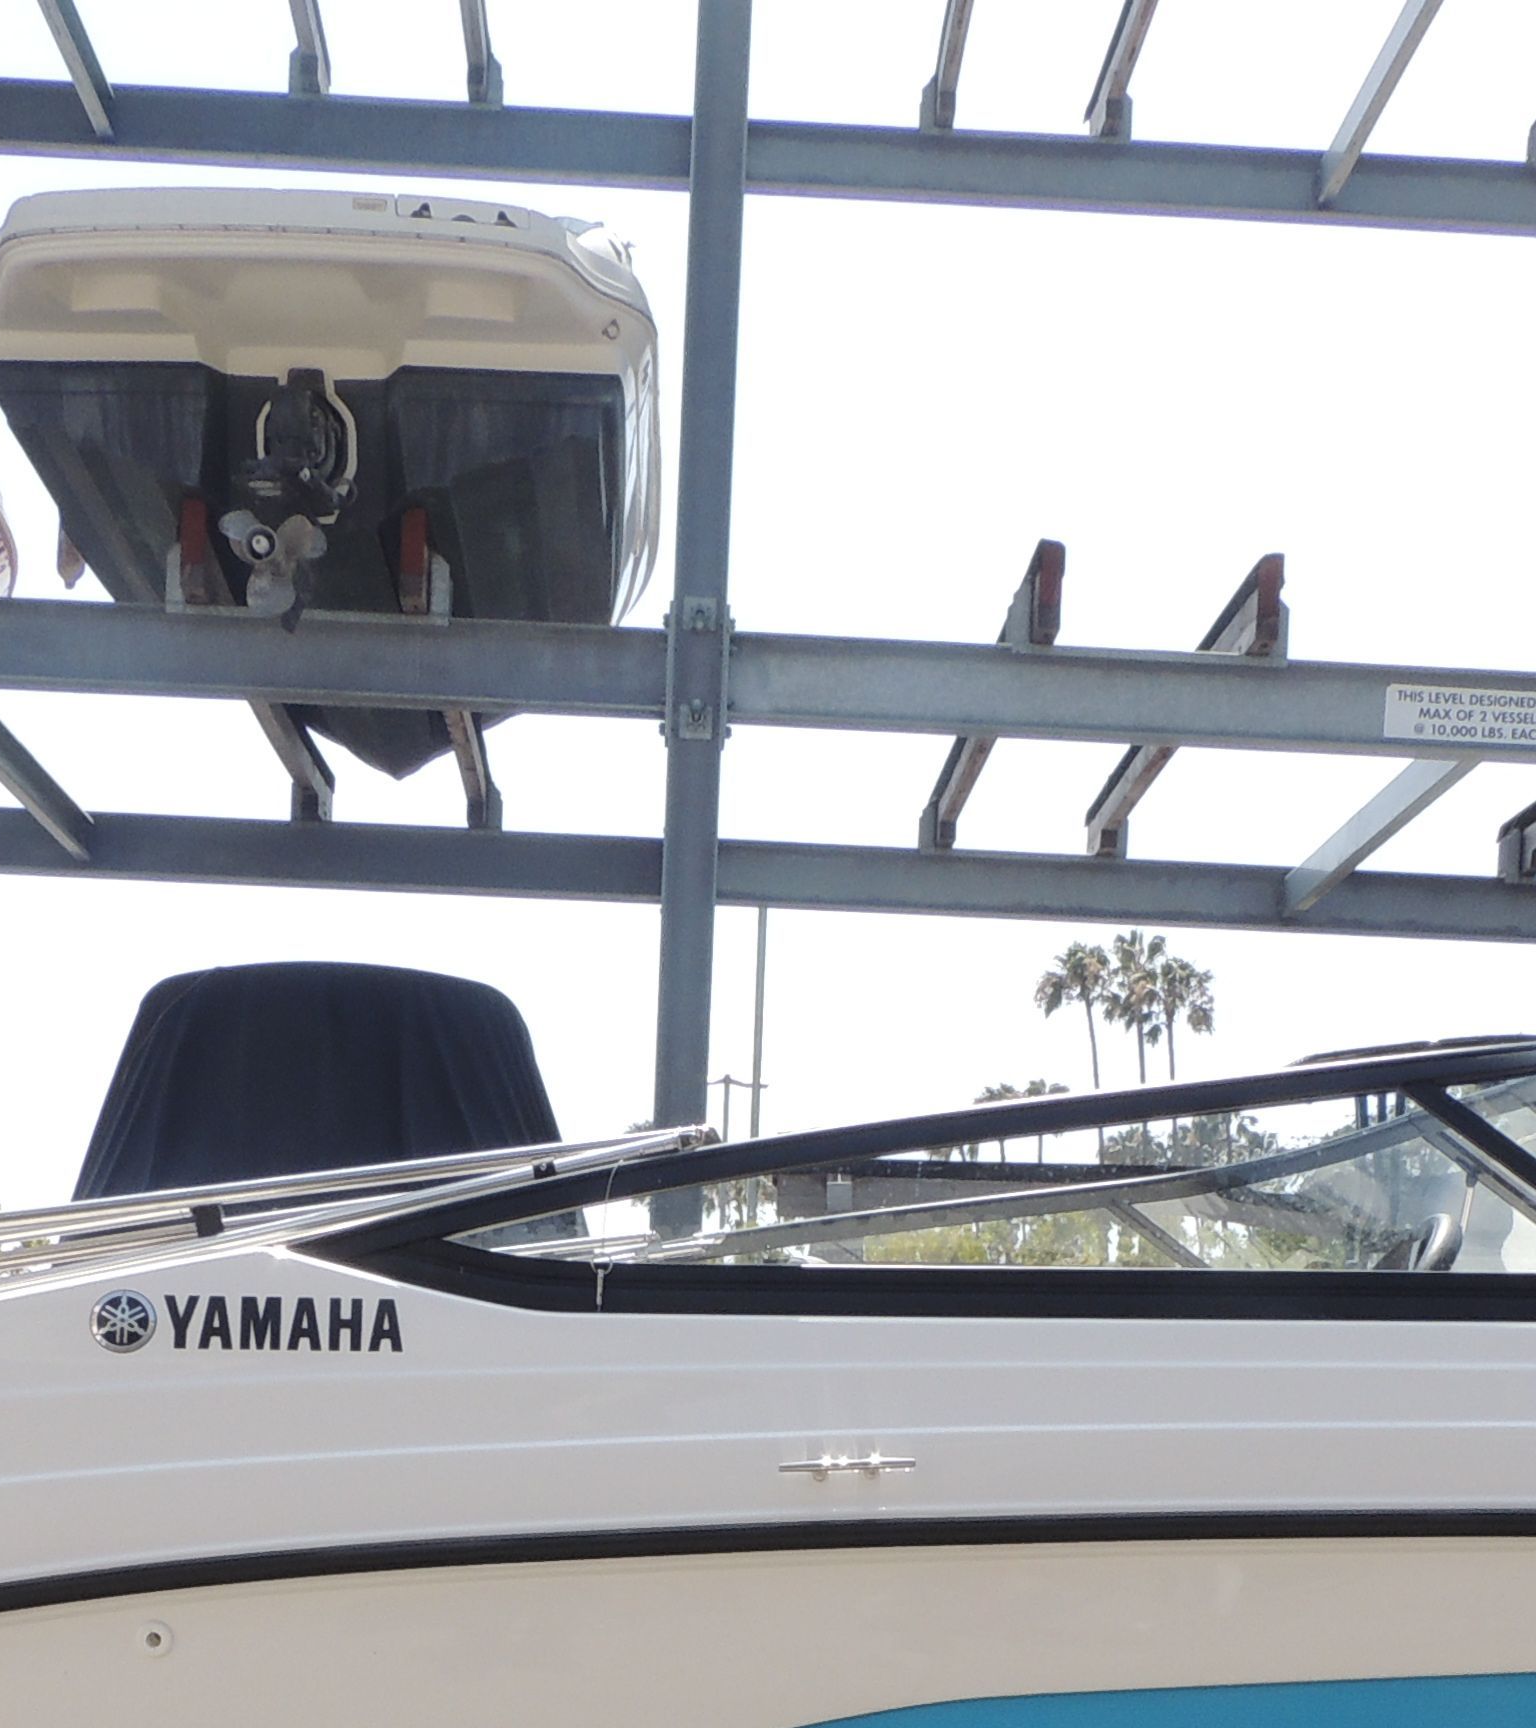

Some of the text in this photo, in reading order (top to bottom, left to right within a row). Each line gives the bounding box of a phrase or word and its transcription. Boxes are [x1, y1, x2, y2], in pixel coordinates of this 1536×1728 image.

[1398, 690, 1424, 703] THIS
[1429, 692, 1464, 705] LEVEL
[1469, 694, 1536, 708] DESIGNED
[1418, 708, 1451, 720] MAX
[1456, 710, 1474, 722] OF
[1480, 711, 1487, 722] 2
[164, 1295, 404, 1352] YAMAHA
